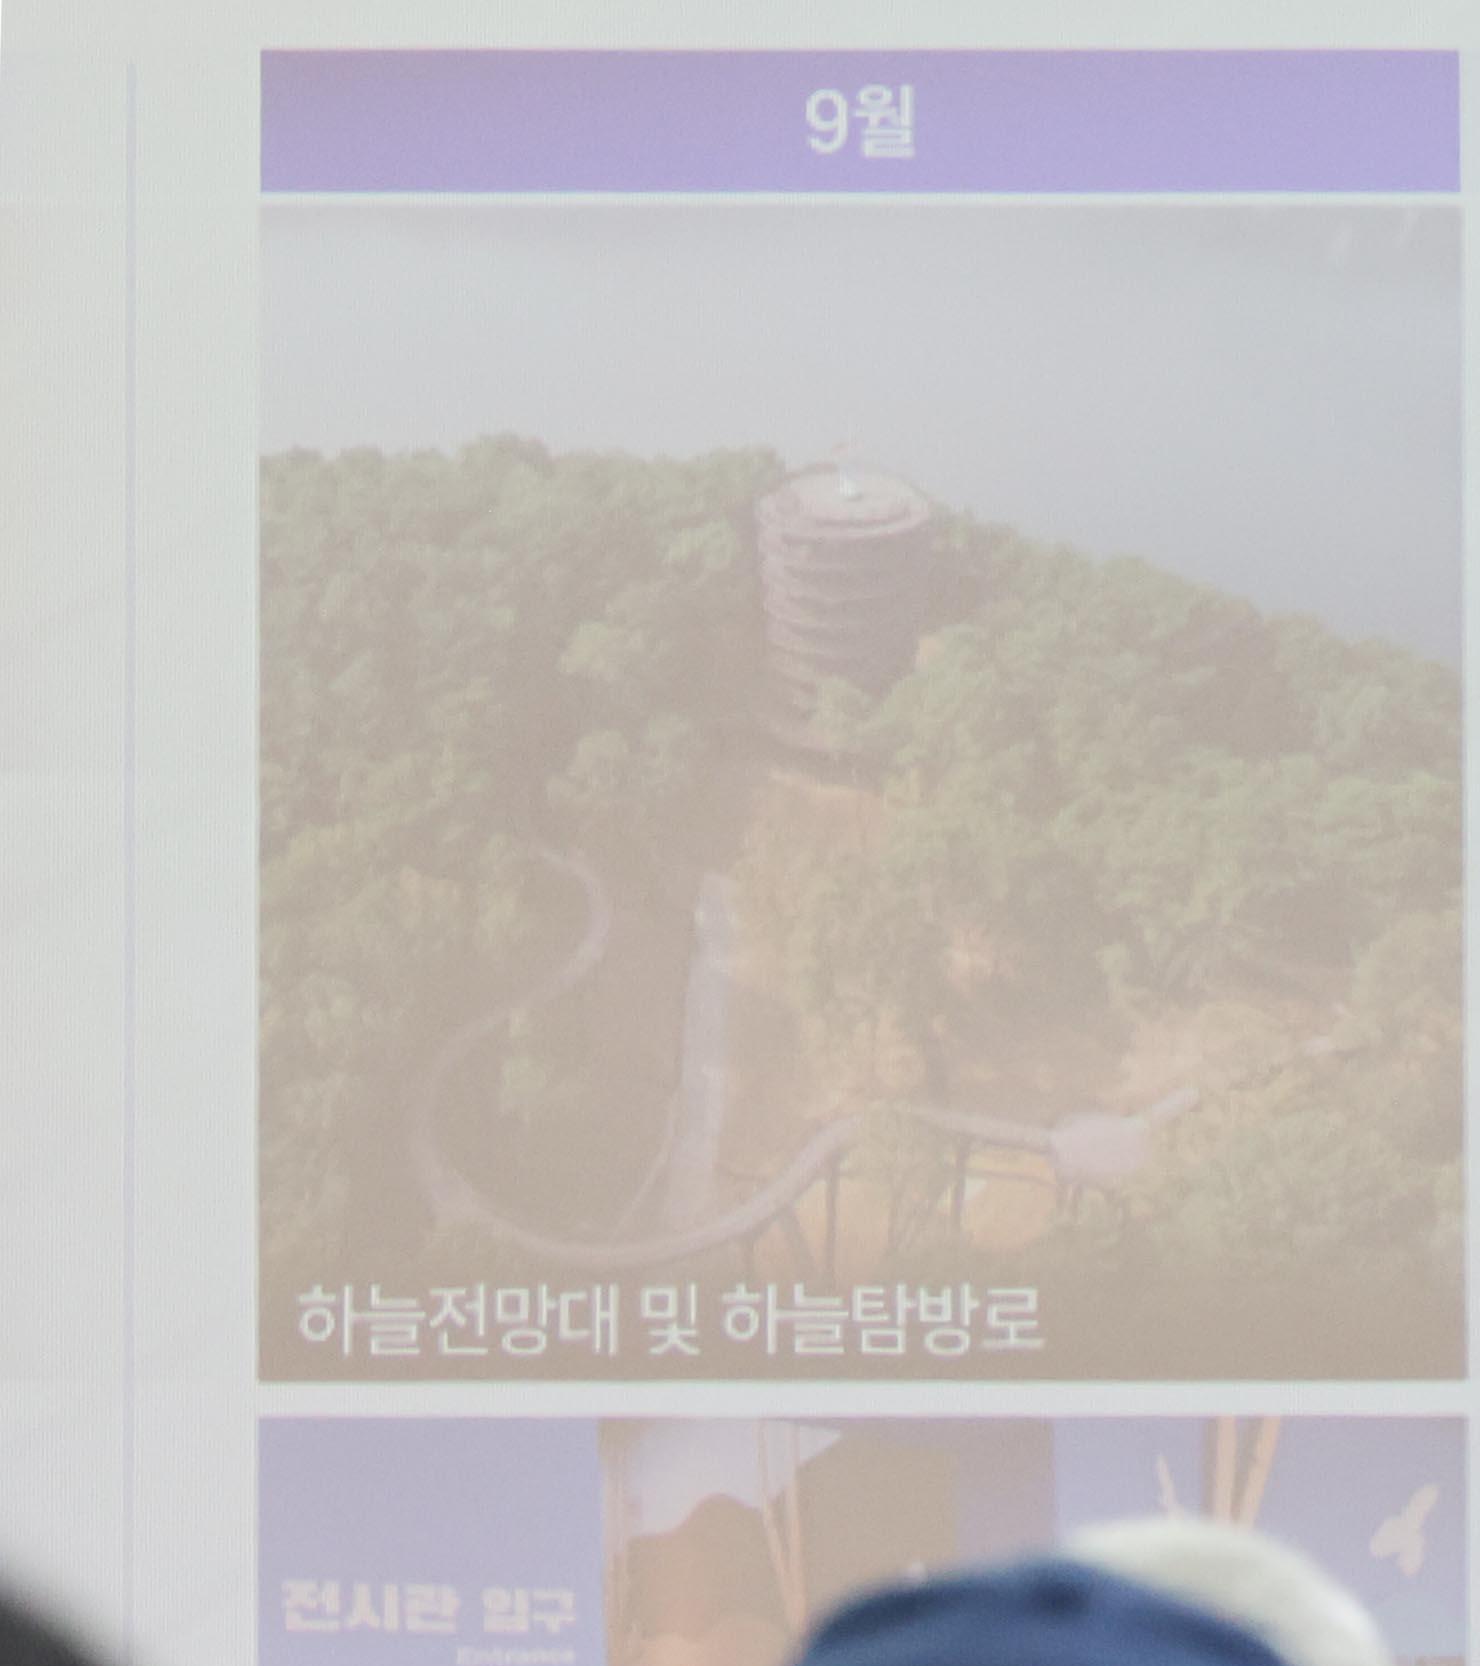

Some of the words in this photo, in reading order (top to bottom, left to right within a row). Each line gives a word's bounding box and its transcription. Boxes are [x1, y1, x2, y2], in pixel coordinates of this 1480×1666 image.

[805, 84, 915, 158] 9월
[296, 1283, 619, 1356] 하늘전망대
[640, 1283, 701, 1356] 및
[721, 1283, 1046, 1356] 하늘탐방로
[281, 1580, 462, 1633] 전시관
[480, 1586, 577, 1634] 입구
